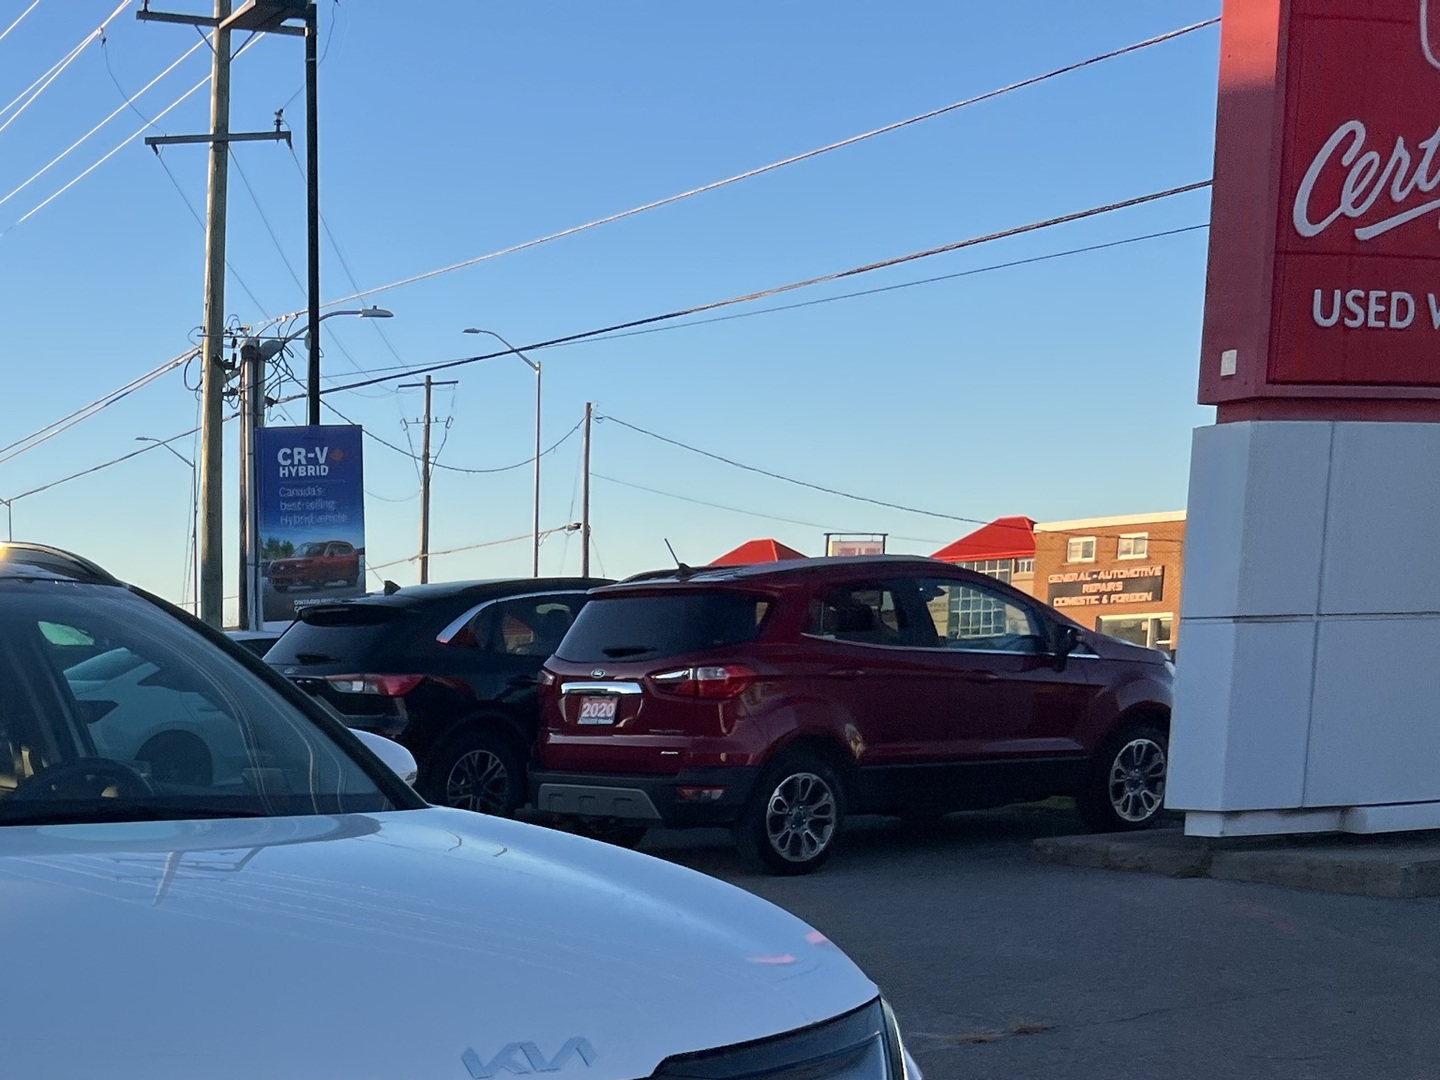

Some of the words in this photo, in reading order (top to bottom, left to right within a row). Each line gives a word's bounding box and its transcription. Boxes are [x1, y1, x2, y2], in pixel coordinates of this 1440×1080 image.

[1312, 288, 1416, 330] USED
[277, 446, 329, 466] CR-V
[279, 465, 329, 478] HYBRID
[1098, 566, 1162, 580] AUTOMOTIVE
[1082, 581, 1123, 594] REPAIRS
[1053, 595, 1100, 607] DOMESTIC
[581, 703, 615, 717] 2020
